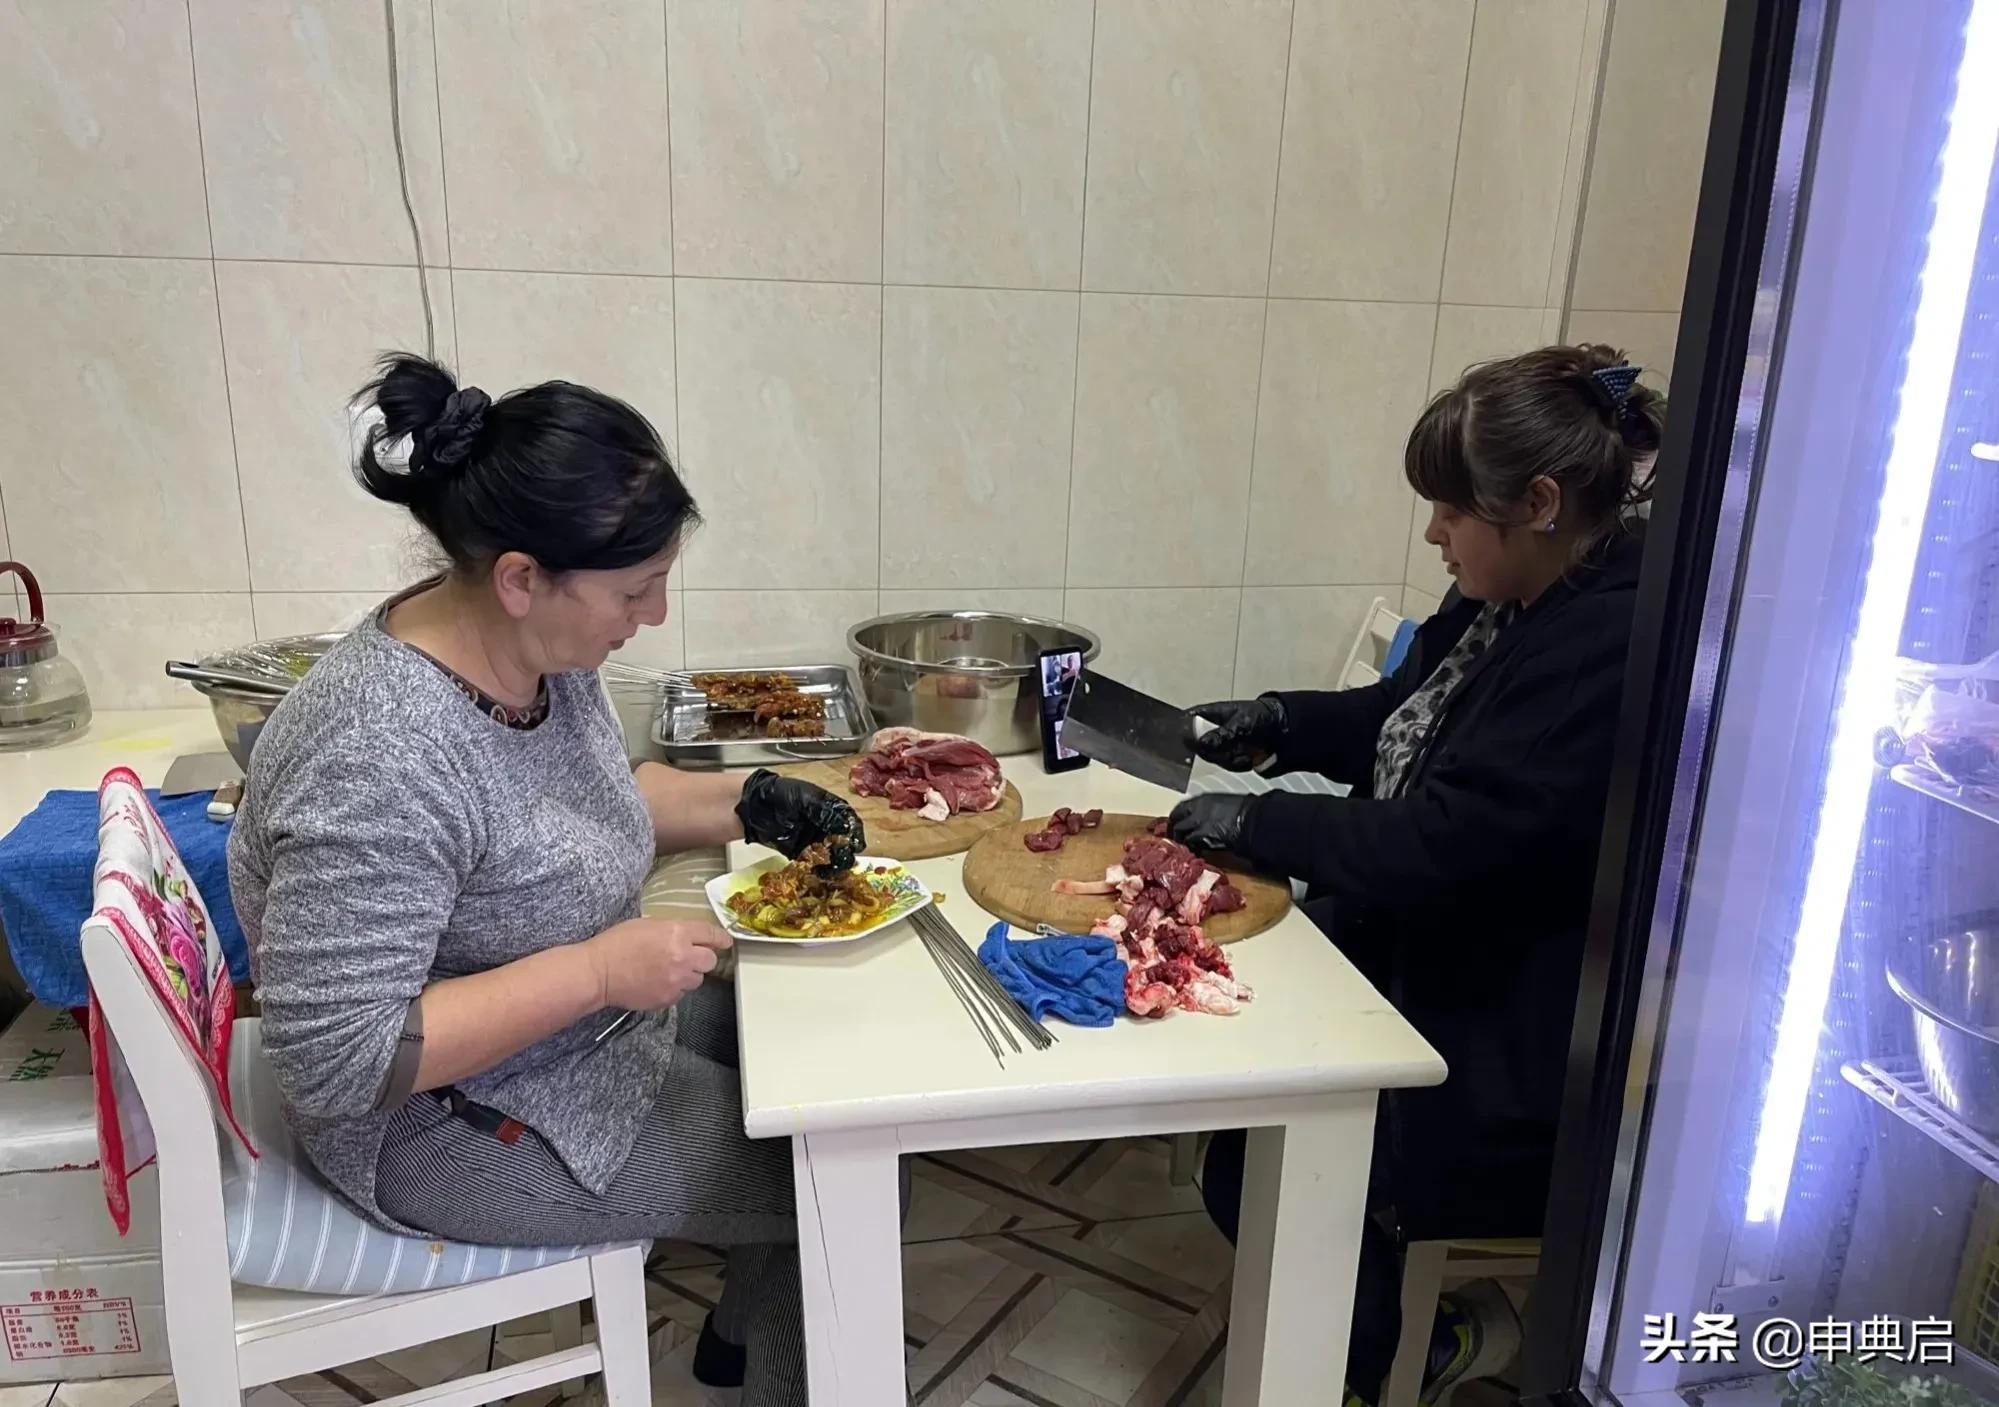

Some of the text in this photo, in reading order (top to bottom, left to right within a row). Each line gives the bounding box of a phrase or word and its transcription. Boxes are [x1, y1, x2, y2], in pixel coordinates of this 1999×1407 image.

[30, 1288, 98, 1302] 营养成分表
